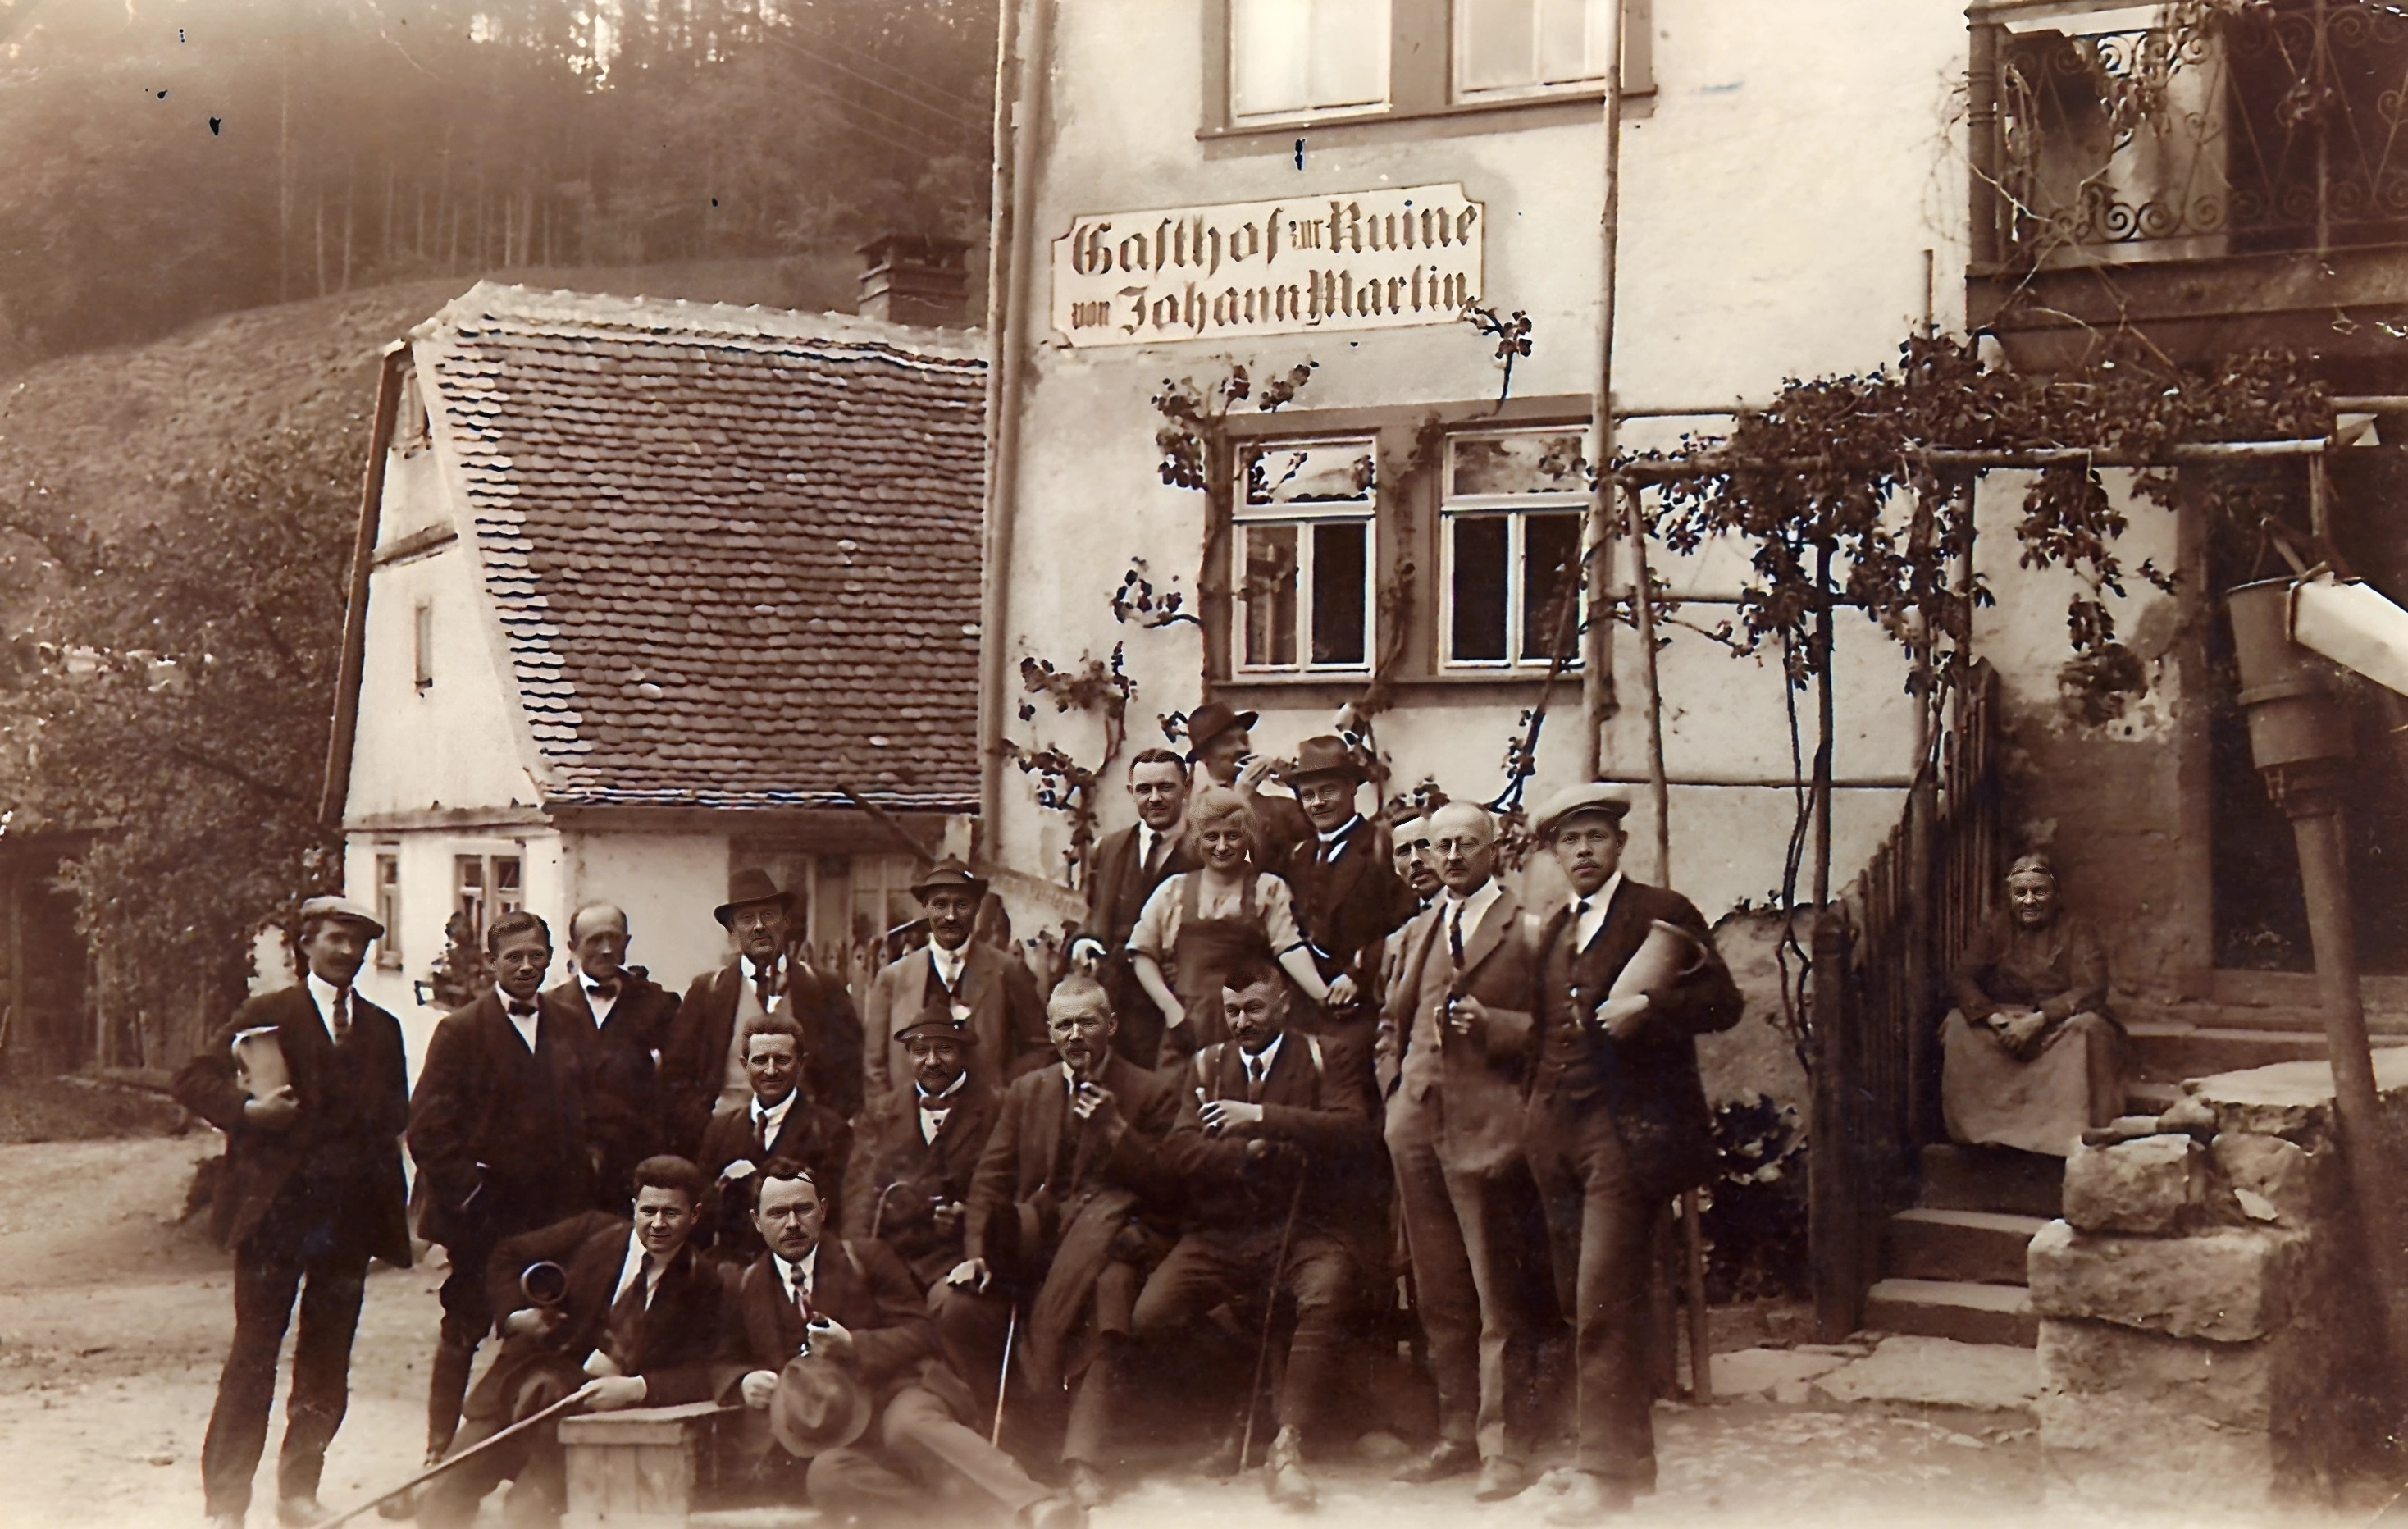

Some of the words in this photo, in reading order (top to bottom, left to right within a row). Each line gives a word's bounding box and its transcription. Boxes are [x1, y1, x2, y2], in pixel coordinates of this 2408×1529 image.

[1072, 207, 1285, 278] Gasthof
[1326, 199, 1478, 255] Ruine
[1072, 300, 1111, 329] von
[1116, 279, 1299, 336] Johann
[1307, 263, 1469, 326] Martin
